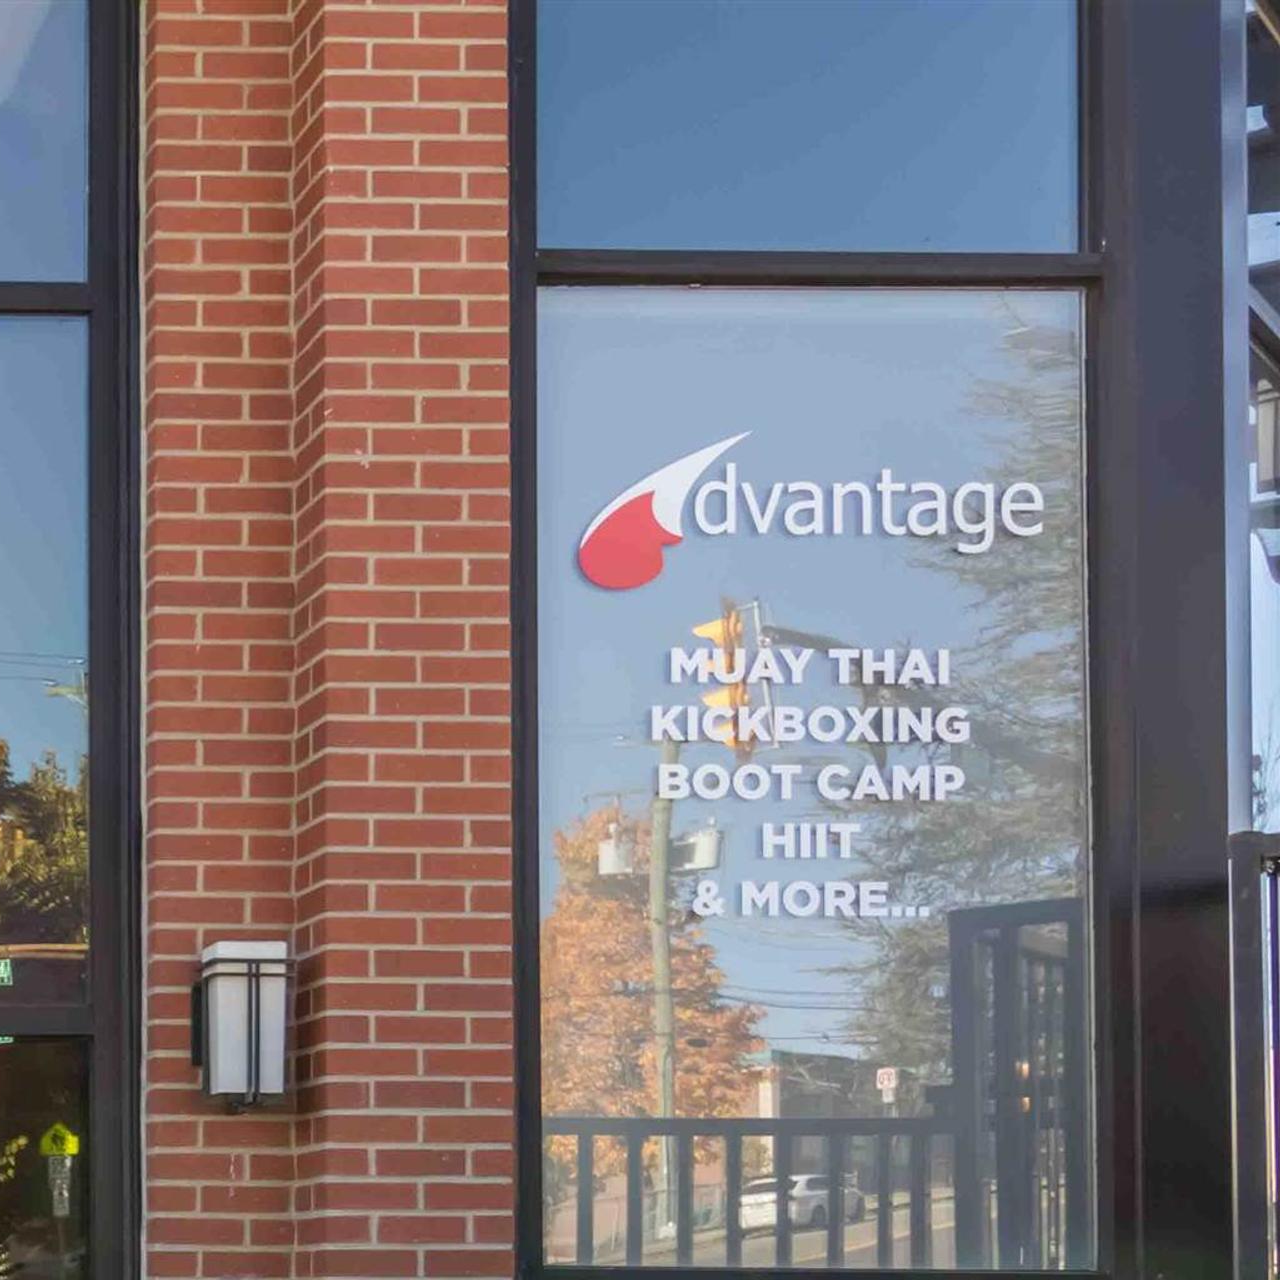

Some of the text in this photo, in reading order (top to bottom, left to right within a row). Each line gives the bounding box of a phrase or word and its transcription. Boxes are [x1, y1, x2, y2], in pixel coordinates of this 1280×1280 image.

[669, 647, 951, 686] MUAY THAI
[651, 705, 972, 744] KICKBOXING
[658, 764, 966, 803] BOOT CAMP
[762, 823, 861, 859] HIIT
[692, 880, 930, 918] & MORE...
